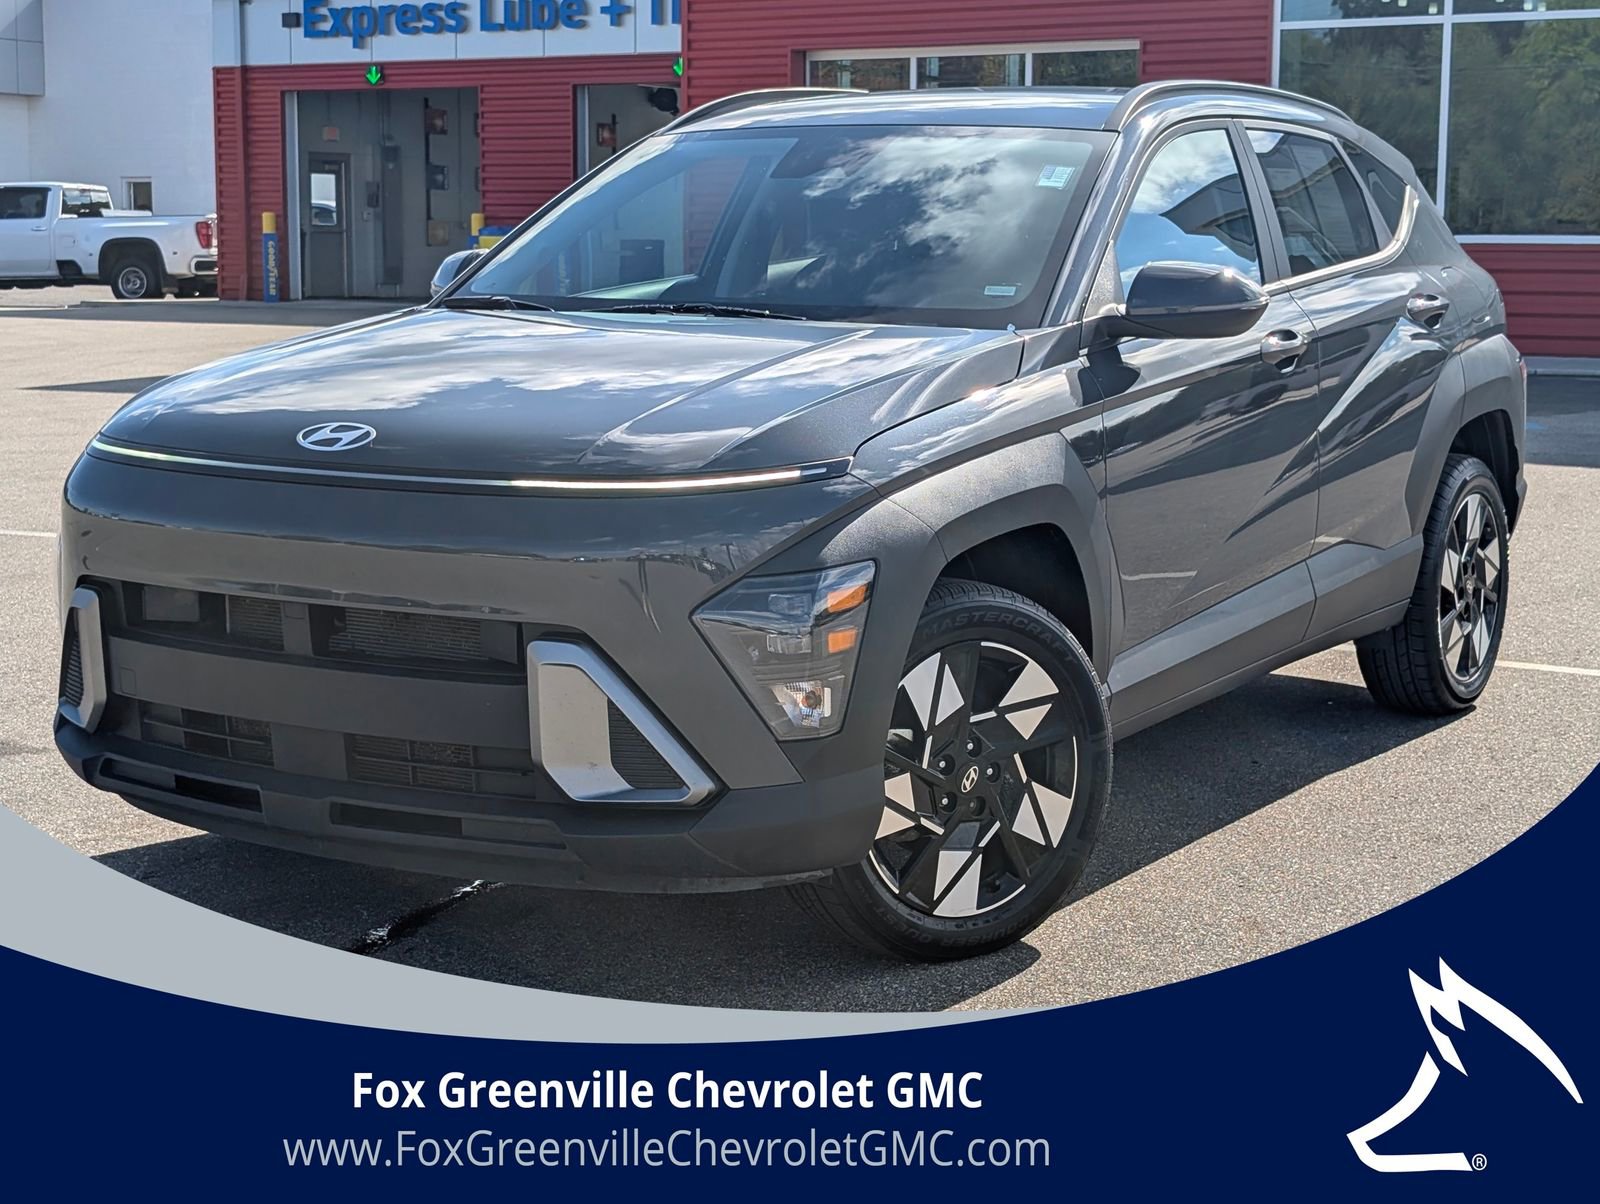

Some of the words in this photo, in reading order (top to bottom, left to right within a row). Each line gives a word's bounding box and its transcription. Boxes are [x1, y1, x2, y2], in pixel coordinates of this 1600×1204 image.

[303, 0, 469, 49] Express
[479, 0, 588, 32] Lube
[266, 240, 279, 296] GOODYEAR
[922, 610, 1079, 665] MASTERCRAFT
